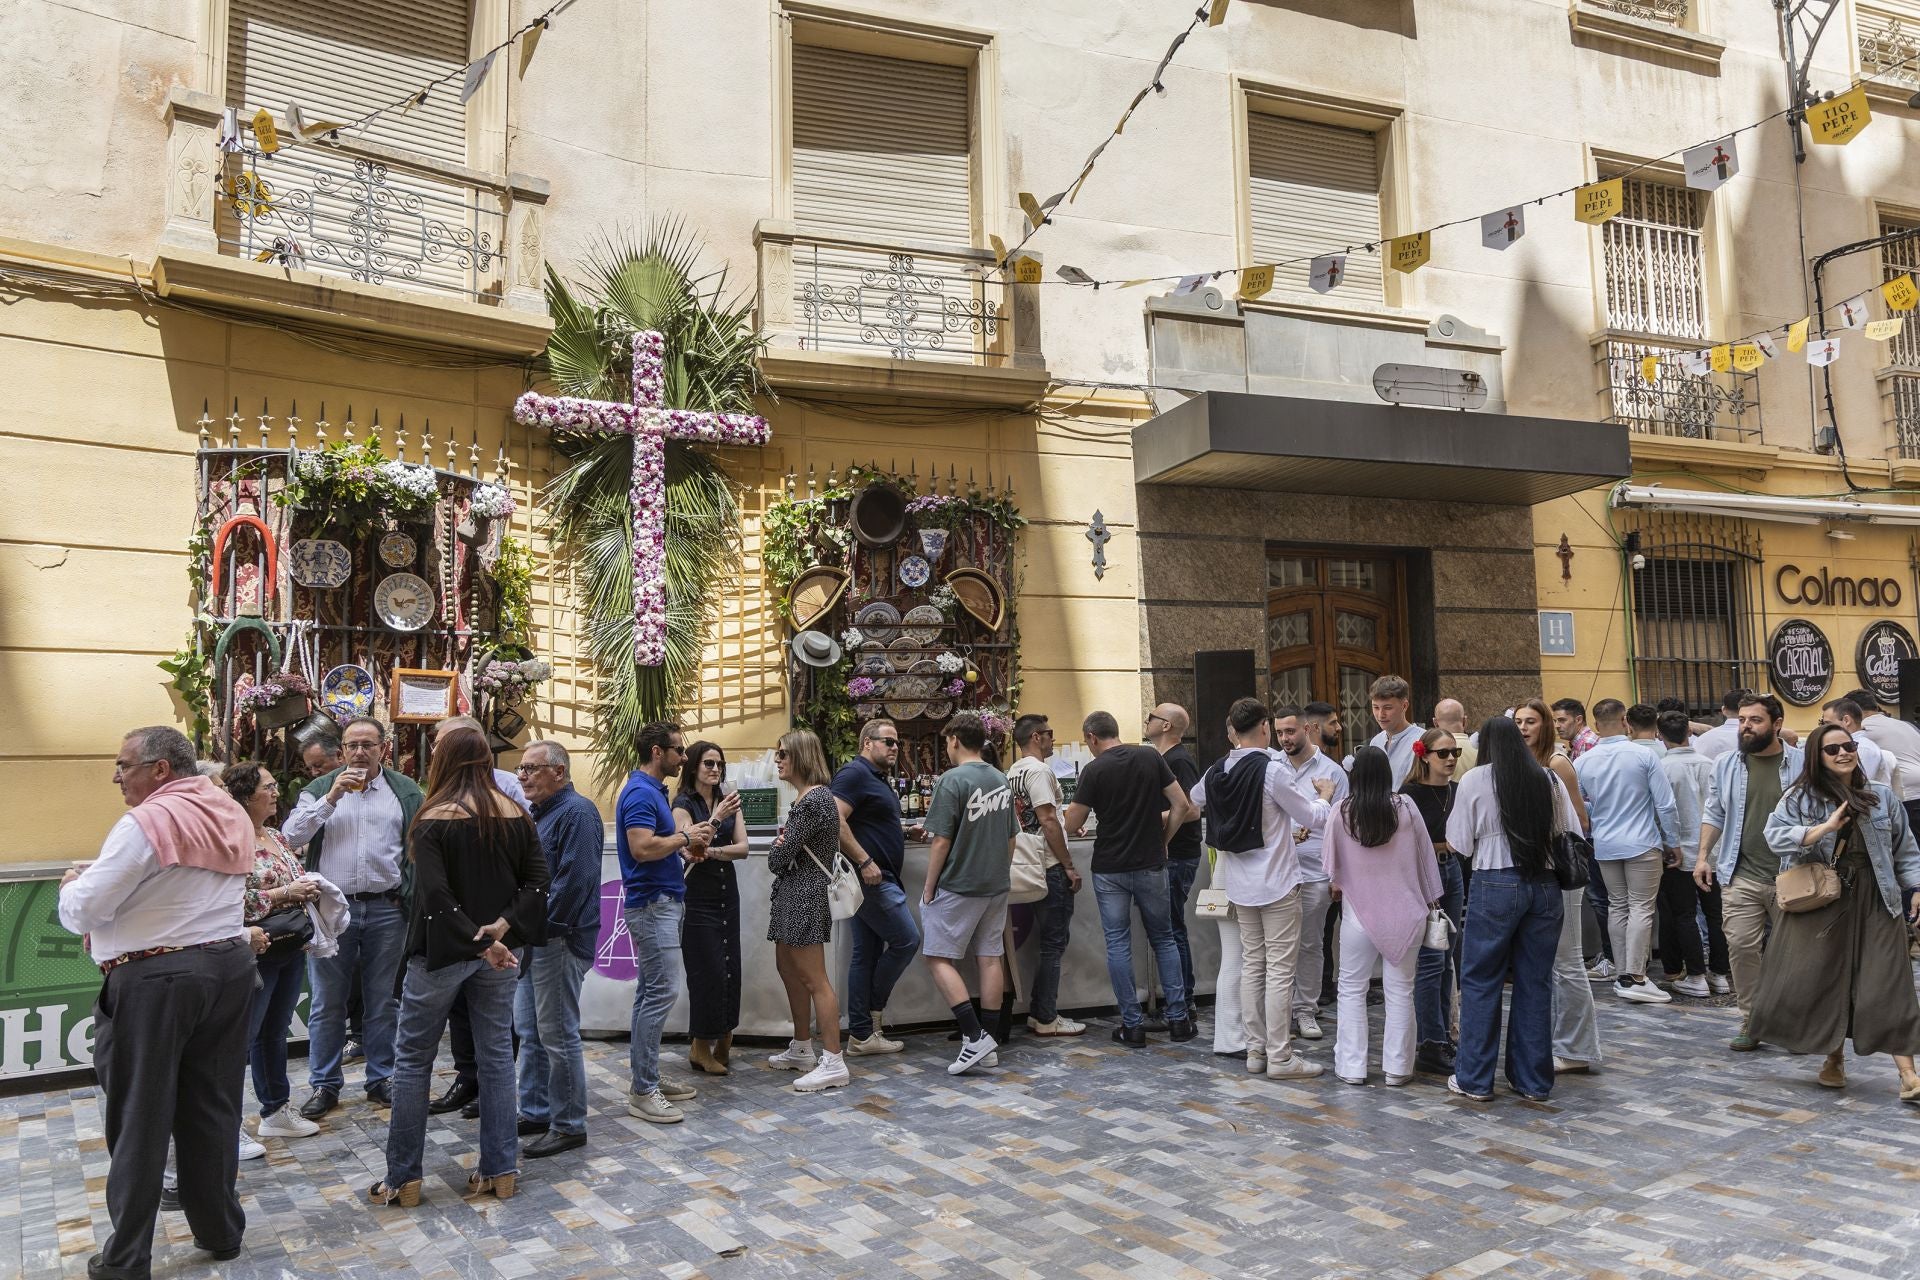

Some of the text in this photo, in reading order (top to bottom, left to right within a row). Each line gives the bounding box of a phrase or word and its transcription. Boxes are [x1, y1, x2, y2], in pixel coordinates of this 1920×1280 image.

[1823, 102, 1850, 119] TIO
[1822, 110, 1859, 132] PEPE
[1587, 189, 1609, 201] TIO
[1584, 198, 1613, 213] PEPE
[1401, 240, 1420, 251] TIO
[1398, 248, 1423, 261] PEPE
[1251, 272, 1265, 281] TIO
[1247, 280, 1267, 289] PEPE
[1891, 281, 1905, 294] TIO
[1892, 289, 1912, 302] PEPE
[1776, 564, 1902, 607] Colmao
[1549, 619, 1564, 636] H
